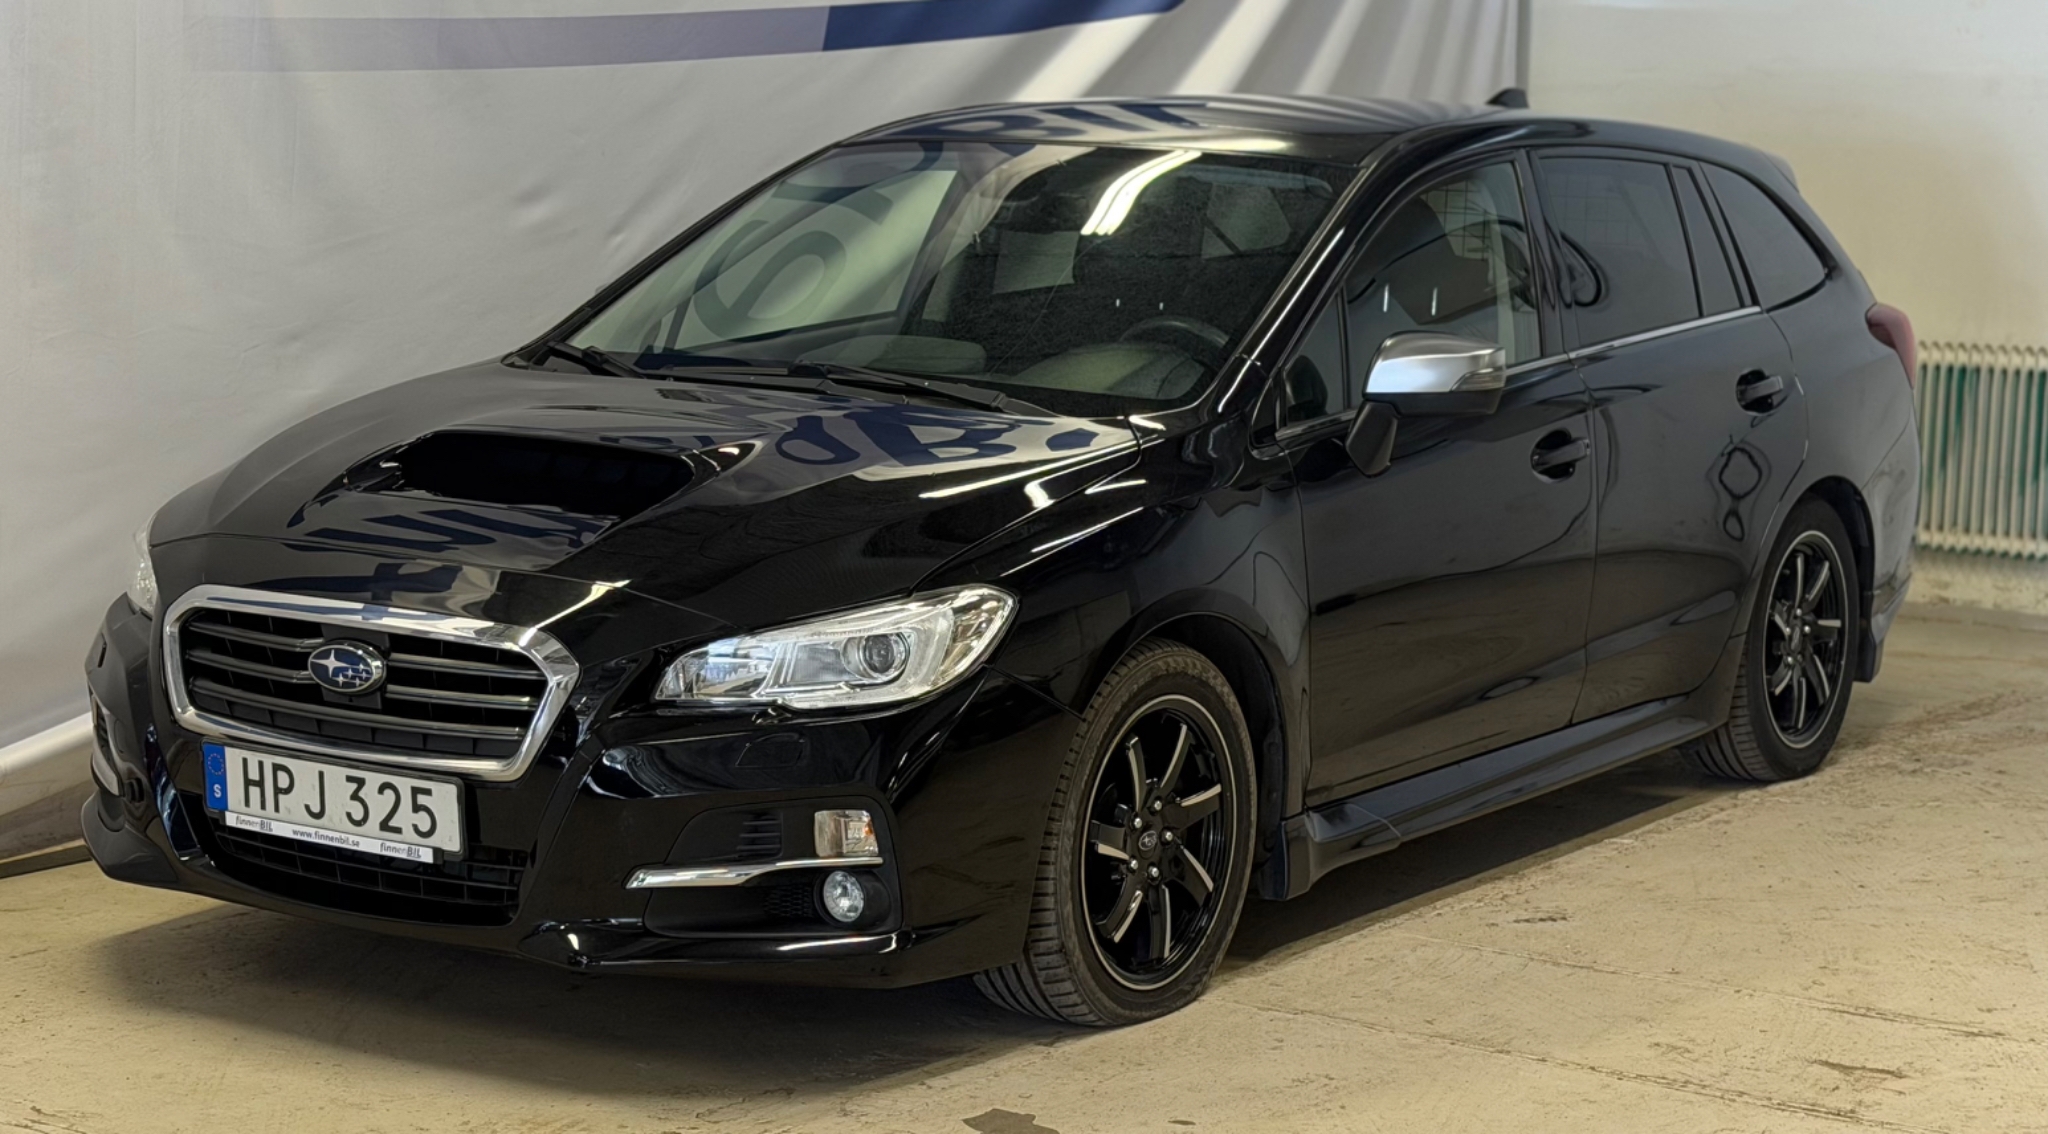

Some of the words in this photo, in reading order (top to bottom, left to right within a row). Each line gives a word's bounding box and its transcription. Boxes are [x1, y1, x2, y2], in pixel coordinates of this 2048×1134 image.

[213, 783, 222, 798] S
[242, 757, 326, 820] HPJ
[345, 774, 437, 839] 325
[292, 829, 360, 848] www.finnenbil.se
